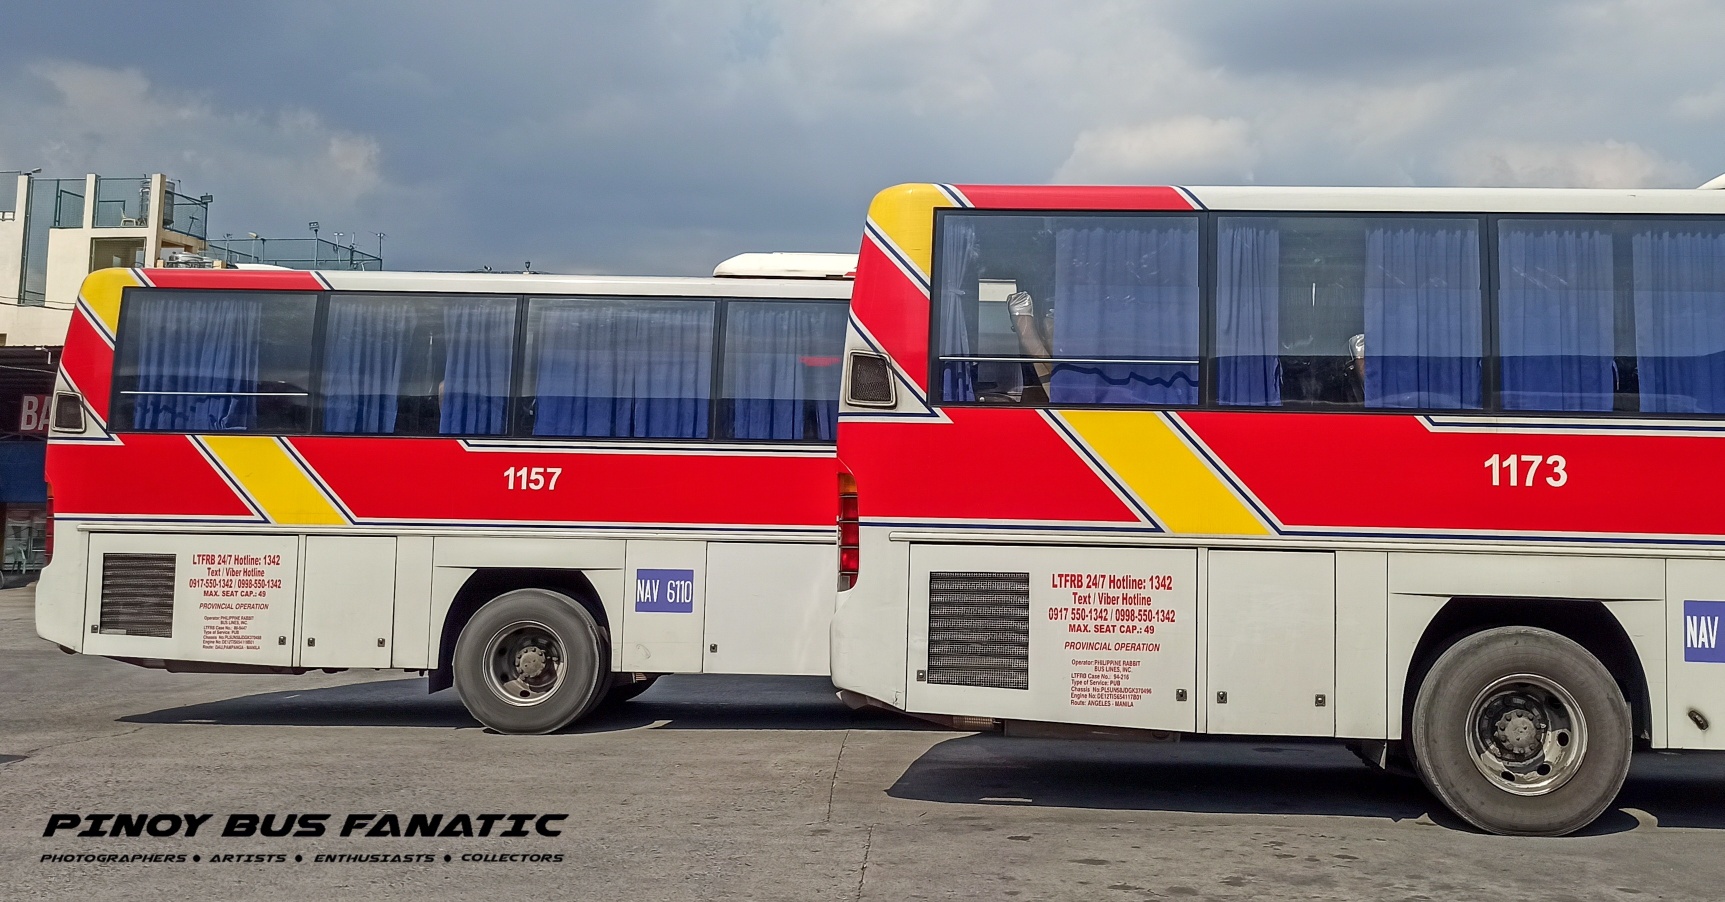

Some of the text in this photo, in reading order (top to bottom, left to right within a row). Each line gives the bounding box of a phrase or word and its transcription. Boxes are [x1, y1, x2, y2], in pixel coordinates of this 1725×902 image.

[1484, 454, 1568, 487] 1173
[504, 466, 562, 490] 1157
[192, 554, 280, 565] LTFRB 24/7 Hotline: 1342
[207, 568, 221, 577] Text
[226, 568, 241, 577] Viber
[243, 568, 264, 577] Hotline
[189, 579, 233, 588] 0917-550-1342
[238, 579, 281, 588] 0998-550-1342
[1052, 574, 1173, 590] LTFRB 24/7 Hotline: 1342
[637, 579, 692, 603] NAV 6110
[1072, 592, 1091, 605] Text
[1098, 592, 1120, 605] Viber
[1122, 593, 1152, 606] Hotline
[1049, 608, 1068, 620] 0917
[1071, 608, 1108, 621] 550-1342
[1115, 609, 1175, 623] 0998-550-1342
[1069, 624, 1154, 634] MAX. SEAT CAP.: 49
[1687, 616, 1719, 648] NAV
[1064, 642, 1160, 652] PROVINCIAL OPERATION
